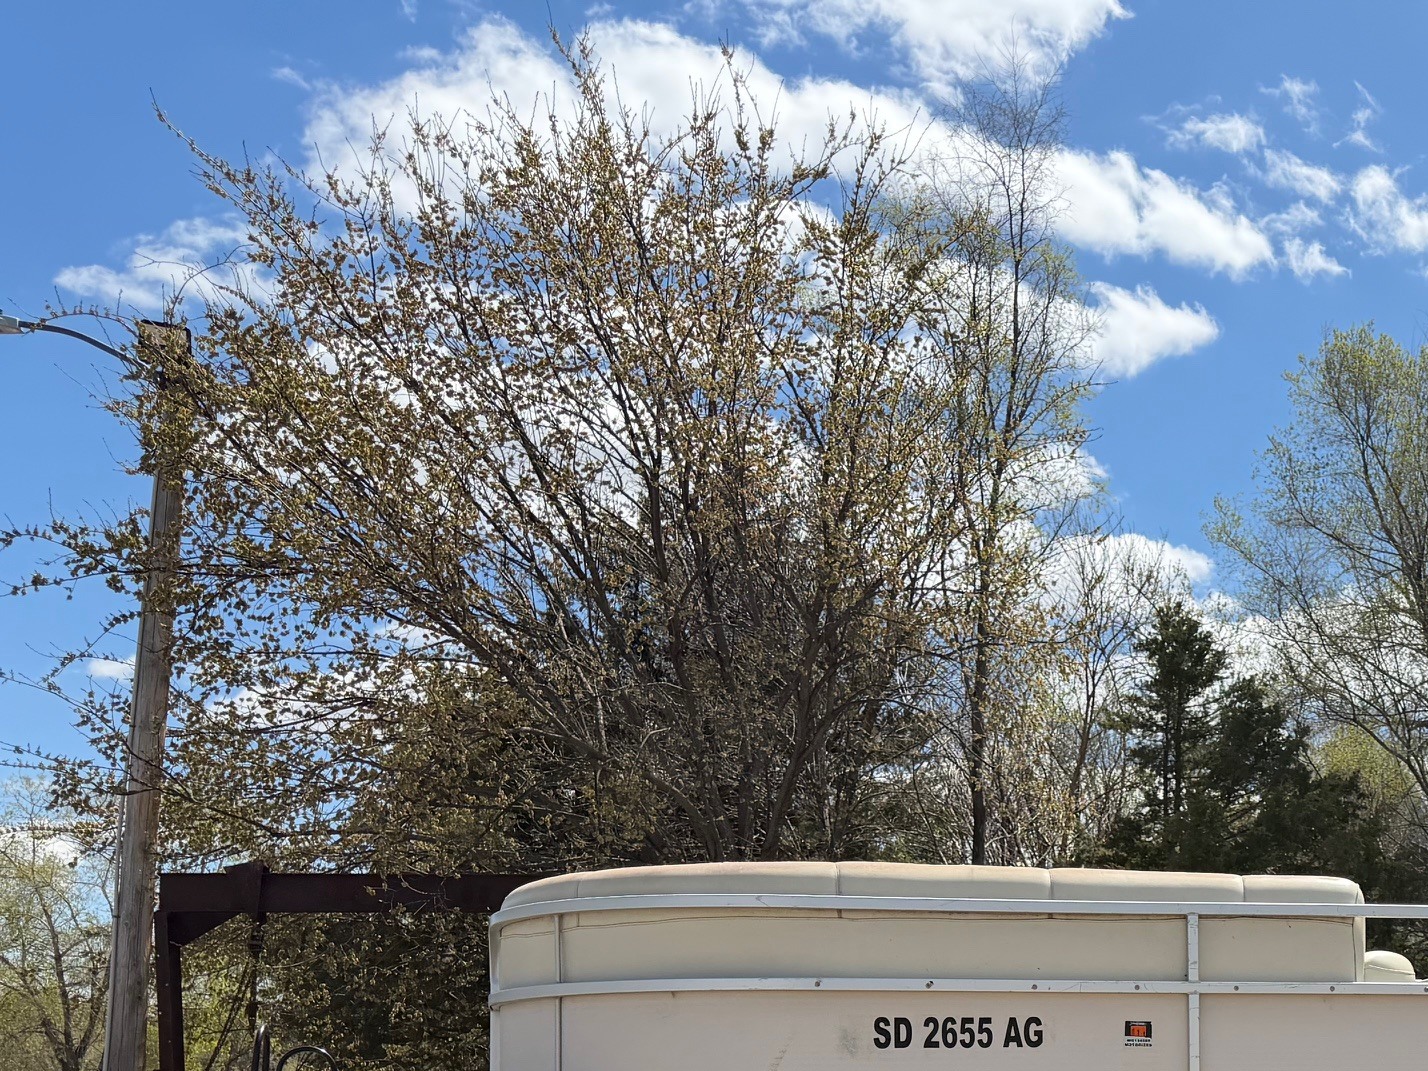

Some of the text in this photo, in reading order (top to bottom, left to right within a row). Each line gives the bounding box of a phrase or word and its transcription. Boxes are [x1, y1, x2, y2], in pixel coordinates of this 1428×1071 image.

[873, 1016, 1044, 1049] SD 2655 AG
